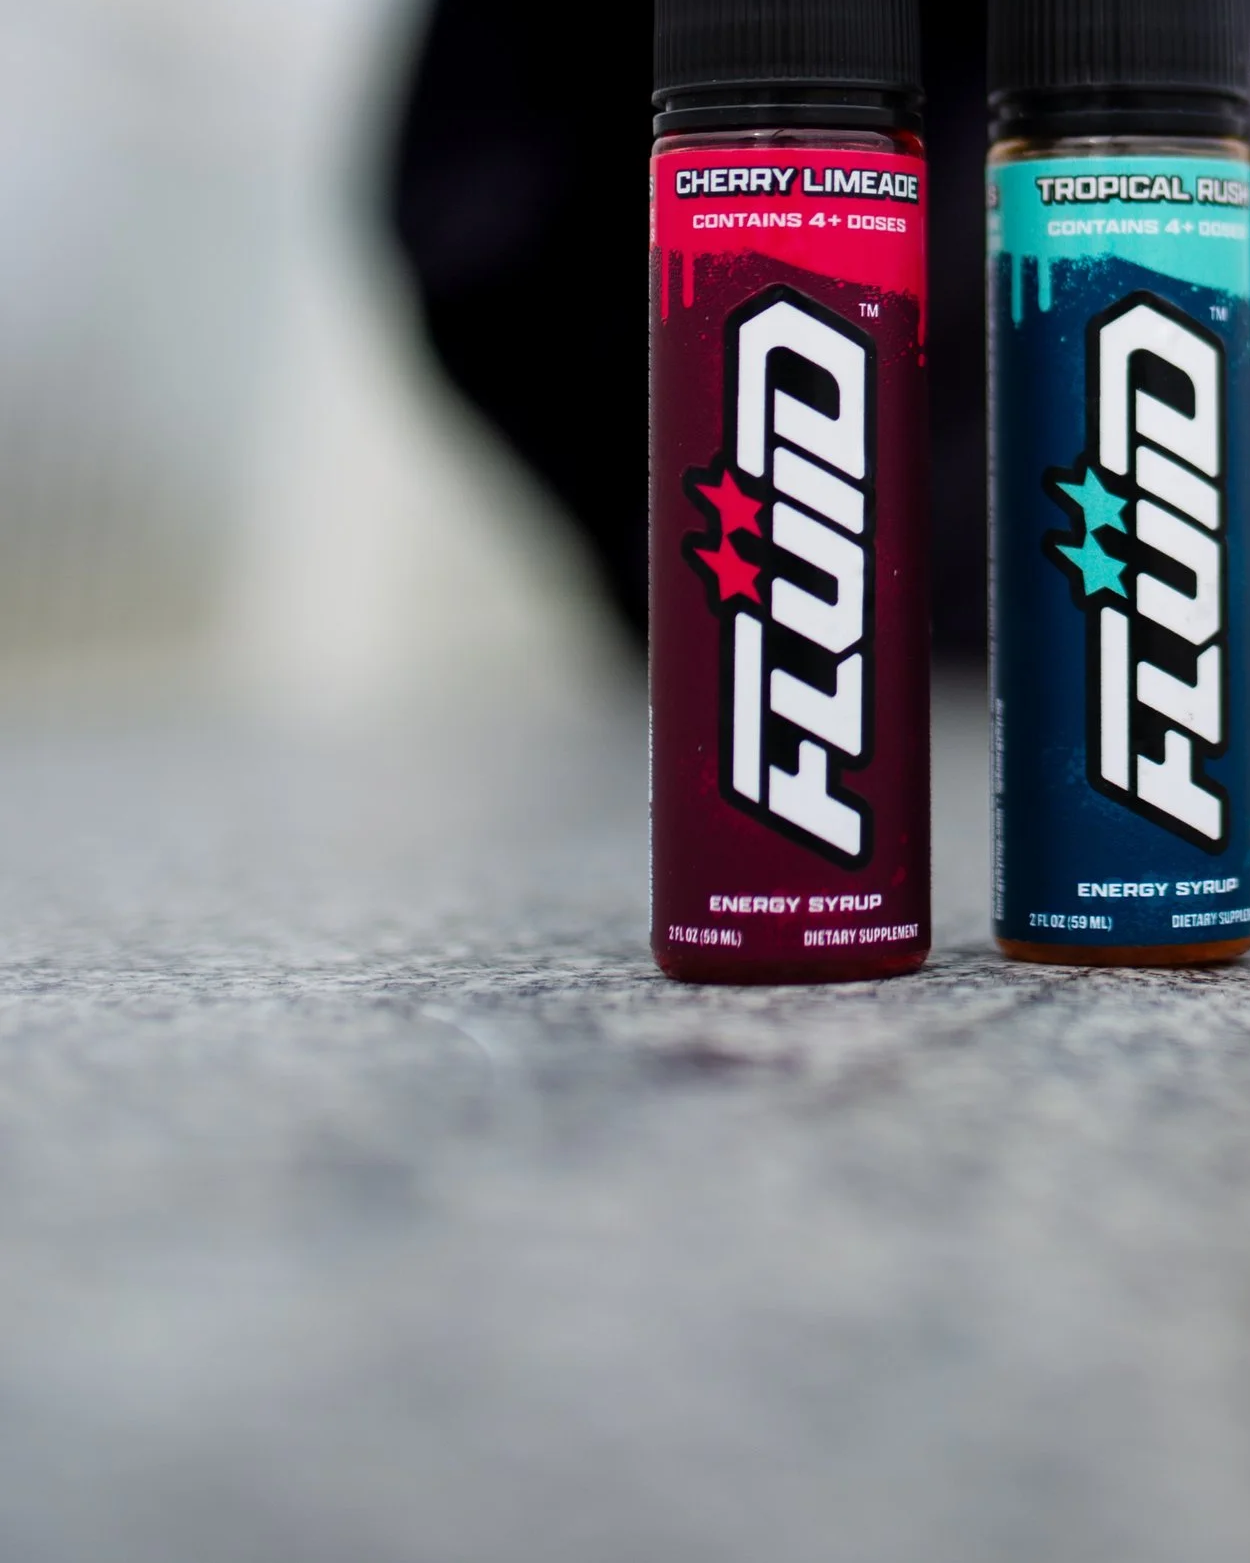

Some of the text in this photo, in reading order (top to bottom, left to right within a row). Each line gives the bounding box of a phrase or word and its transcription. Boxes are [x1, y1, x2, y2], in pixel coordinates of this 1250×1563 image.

[675, 167, 919, 202] CHERRY LIMEADE
[1036, 175, 1193, 204] TROPICAL
[692, 213, 907, 233] CONTAINS 4+ DOSES
[1047, 219, 1159, 236] CONTAINS
[1164, 219, 1194, 235] 4+
[858, 303, 879, 318] TM
[1077, 878, 1239, 897] ENERGY SYRUP
[709, 894, 882, 913] ENERGY SYRUP
[1029, 913, 1112, 932] 2 FL OZ (59 ML)
[1171, 912, 1217, 929] DIETARY
[686, 928, 698, 943] OZ
[699, 929, 718, 945] (59
[720, 929, 742, 948] ML)
[803, 923, 919, 946] DIETARY SUPPLEMENT
